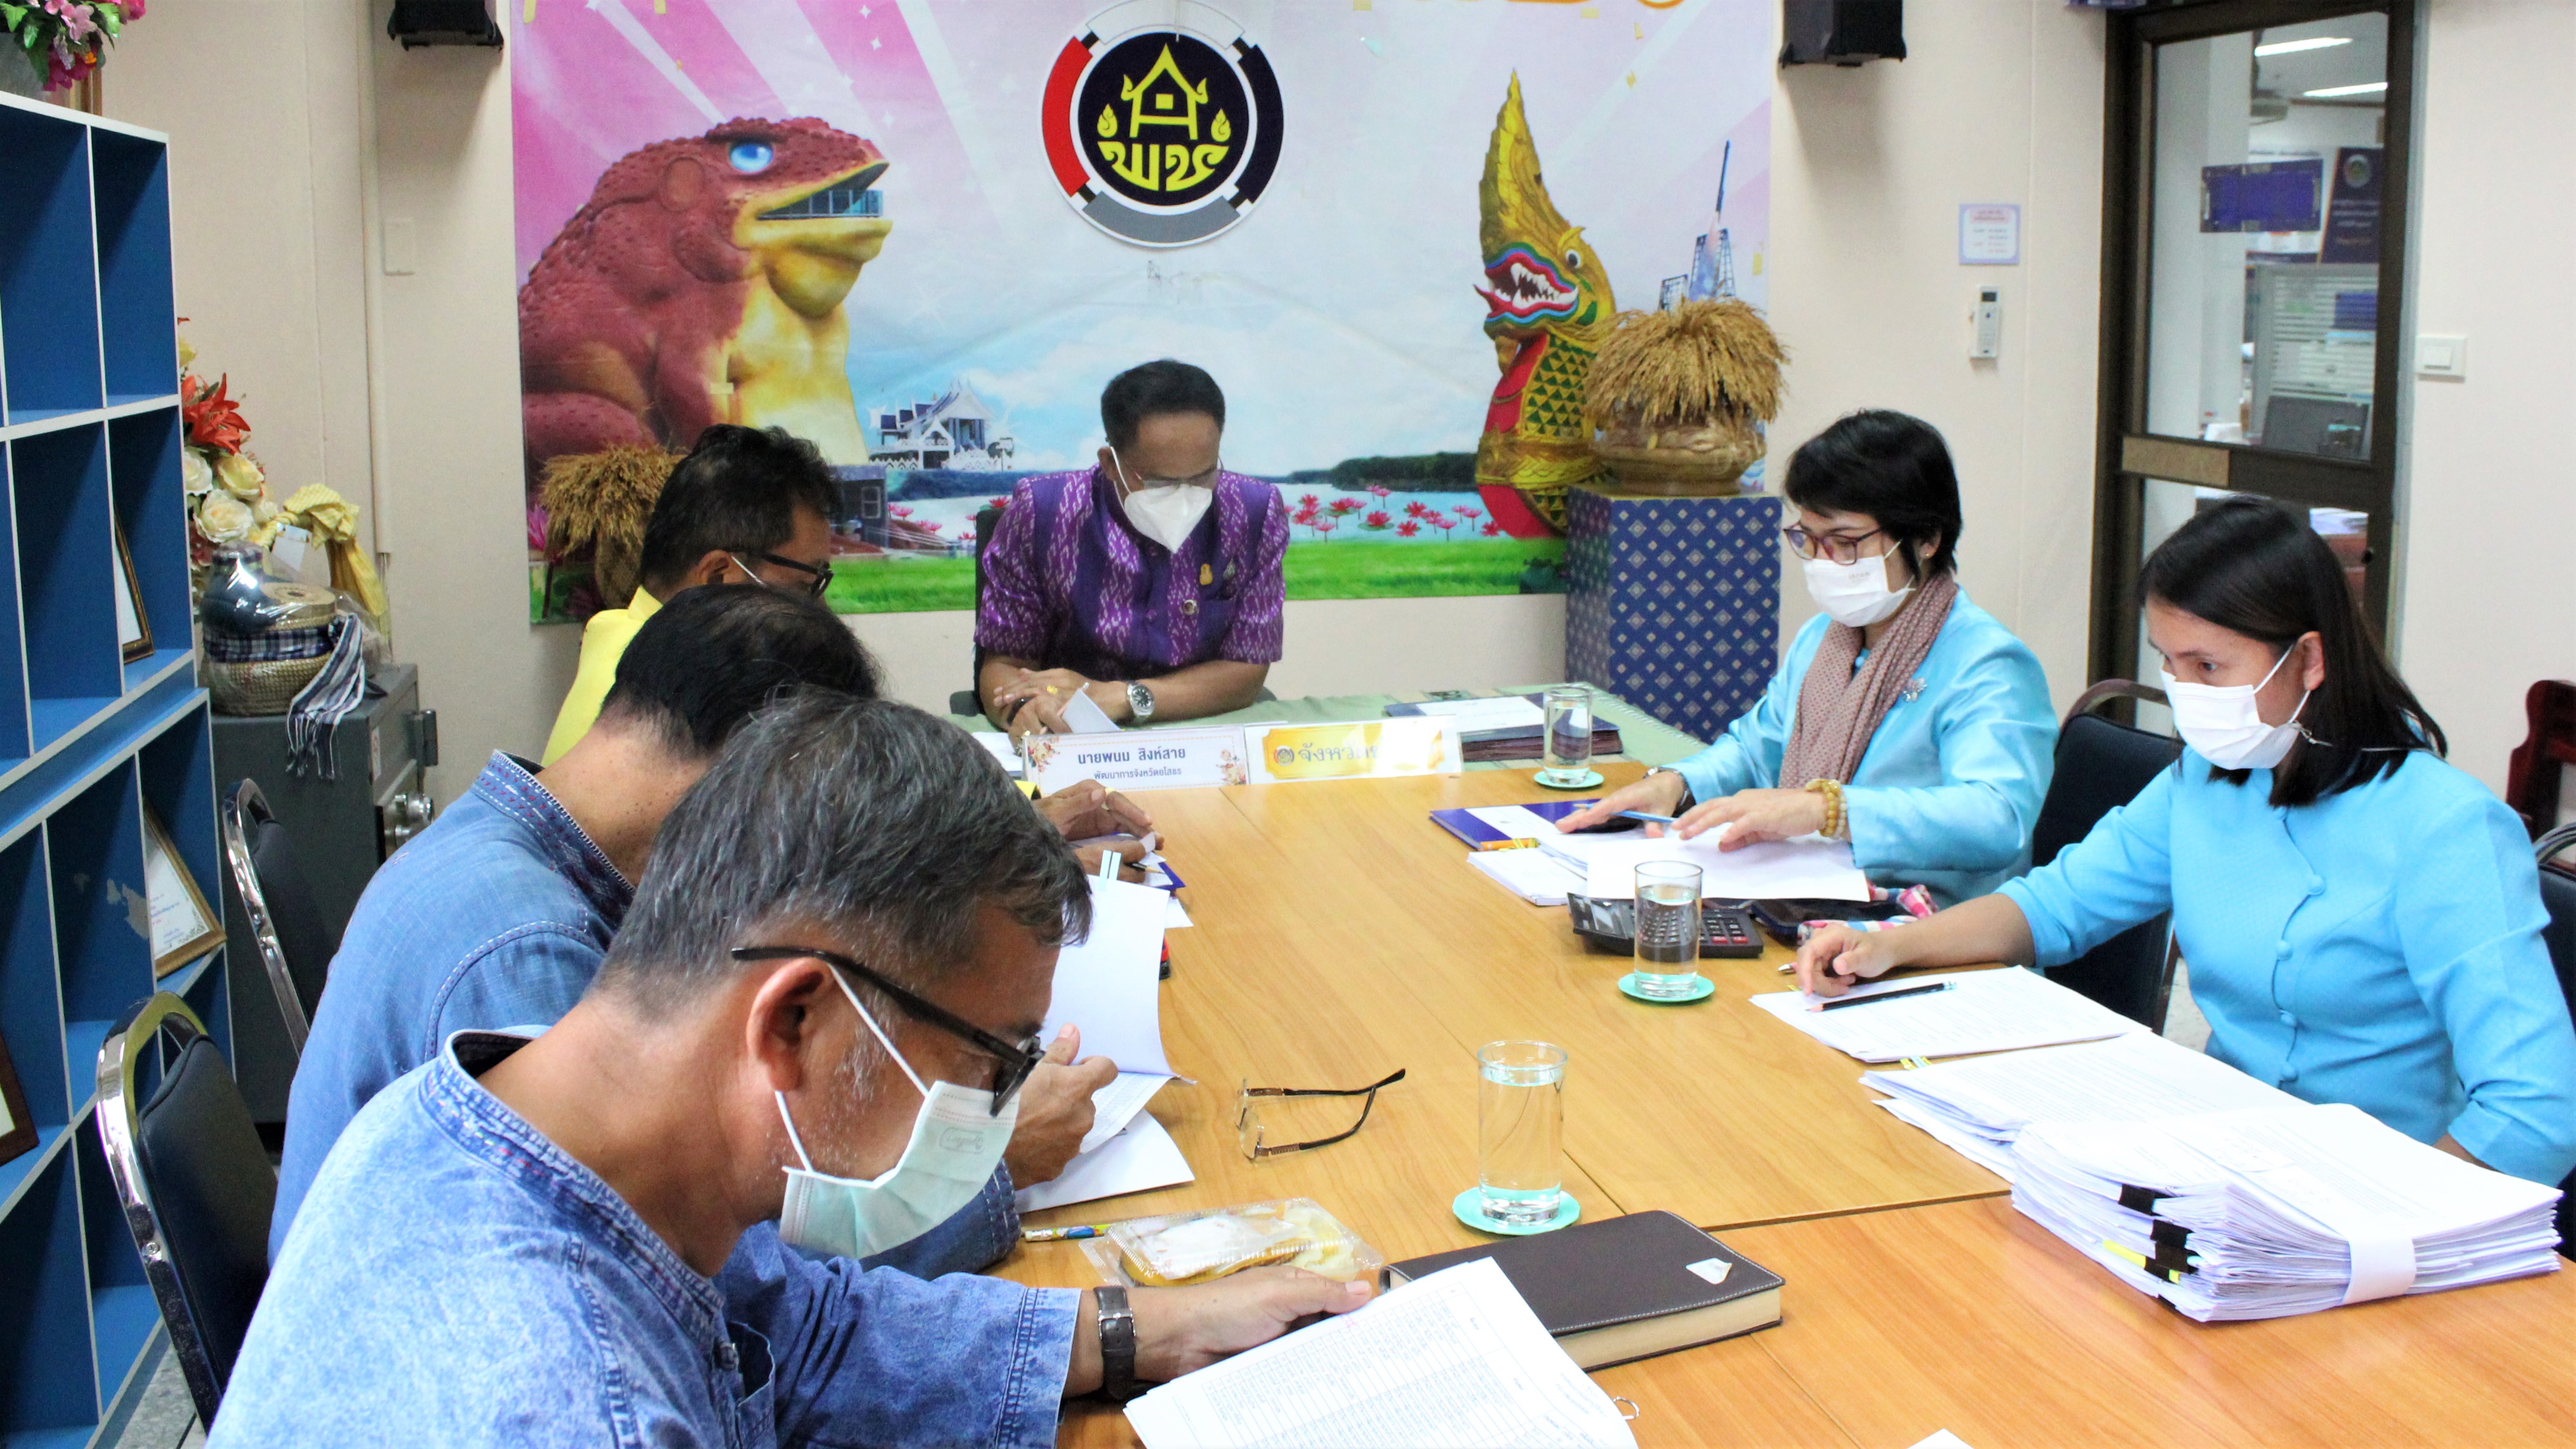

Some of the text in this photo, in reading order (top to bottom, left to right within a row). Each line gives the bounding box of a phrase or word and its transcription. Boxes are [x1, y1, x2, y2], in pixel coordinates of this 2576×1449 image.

[1078, 746, 1186, 764] นายพนม สิงห์สาย
[1093, 766, 1182, 780] พัฒนาการจังหวัดยโสธร
